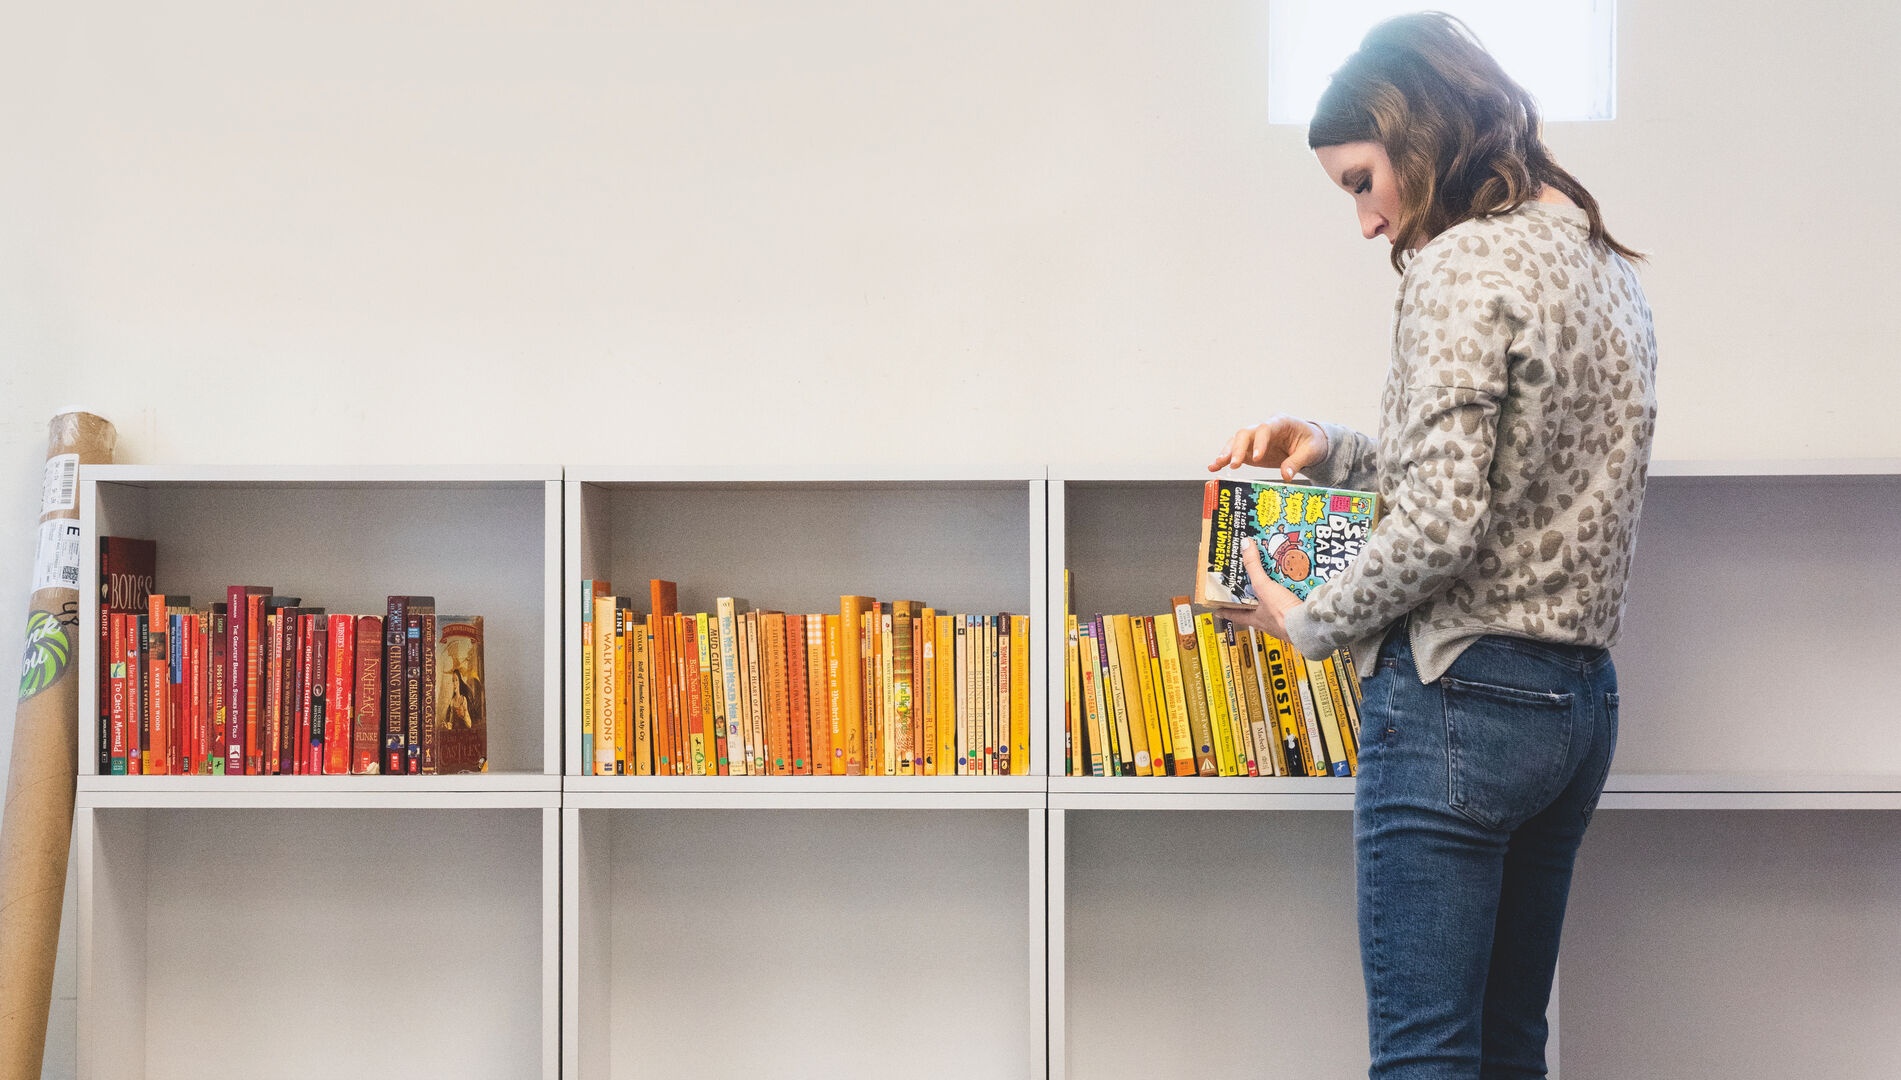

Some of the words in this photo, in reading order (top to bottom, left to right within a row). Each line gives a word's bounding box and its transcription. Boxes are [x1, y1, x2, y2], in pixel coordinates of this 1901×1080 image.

[1218, 489, 1231, 529] CAPTAIN
[1234, 486, 1243, 509] GEORGE
[1233, 510, 1241, 528] BEARD
[67, 526, 80, 537] E
[1214, 530, 1228, 573] UNDERPA
[1231, 537, 1239, 559] HAROLD
[1314, 525, 1332, 582] BABY
[1328, 514, 1349, 578] DIAP
[110, 573, 153, 610] BONES
[337, 621, 345, 648] WEBSTER'S
[686, 620, 695, 643] CURTIS
[709, 629, 718, 650] MUD
[1096, 616, 1104, 640] Roald
[1226, 621, 1234, 643] Greene
[603, 632, 612, 665] WALK
[1000, 645, 1008, 665] ROMAN
[335, 648, 344, 677] Dictionary
[390, 646, 402, 686] CHASING
[425, 652, 433, 675] TALE
[689, 659, 697, 677] Bud,
[711, 652, 720, 673] CITY
[1191, 656, 1199, 670] THE
[1234, 665, 1242, 677] Hall
[114, 681, 123, 691] To
[360, 657, 380, 717] INKHEART
[603, 668, 612, 695] TWO
[637, 672, 644, 680] of
[690, 678, 698, 692] Not
[1000, 665, 1008, 694] MYSTERIES
[1194, 671, 1203, 701] WICKED
[1269, 649, 1292, 716] GHOST
[1328, 671, 1337, 687] Pippi
[113, 693, 123, 713] Catch
[155, 689, 160, 697] IN
[335, 686, 344, 710] Students
[409, 679, 418, 710] CHASING
[702, 674, 711, 715] superfudge
[753, 698, 759, 706] OF
[1168, 691, 1176, 708] SAVED
[129, 688, 137, 723] Blunderland
[389, 688, 401, 733] VERMEER
[691, 694, 700, 717] Buddy
[831, 689, 840, 734] Wonderland
[409, 711, 418, 745] VERMEER
[425, 705, 433, 745] CASTLES
[604, 697, 613, 741] MOONS
[638, 720, 645, 730] My
[113, 720, 123, 752] Mermaid
[356, 731, 378, 742] FUNKE
[926, 733, 934, 757] STINE
[1256, 727, 1266, 752] Macbeth
